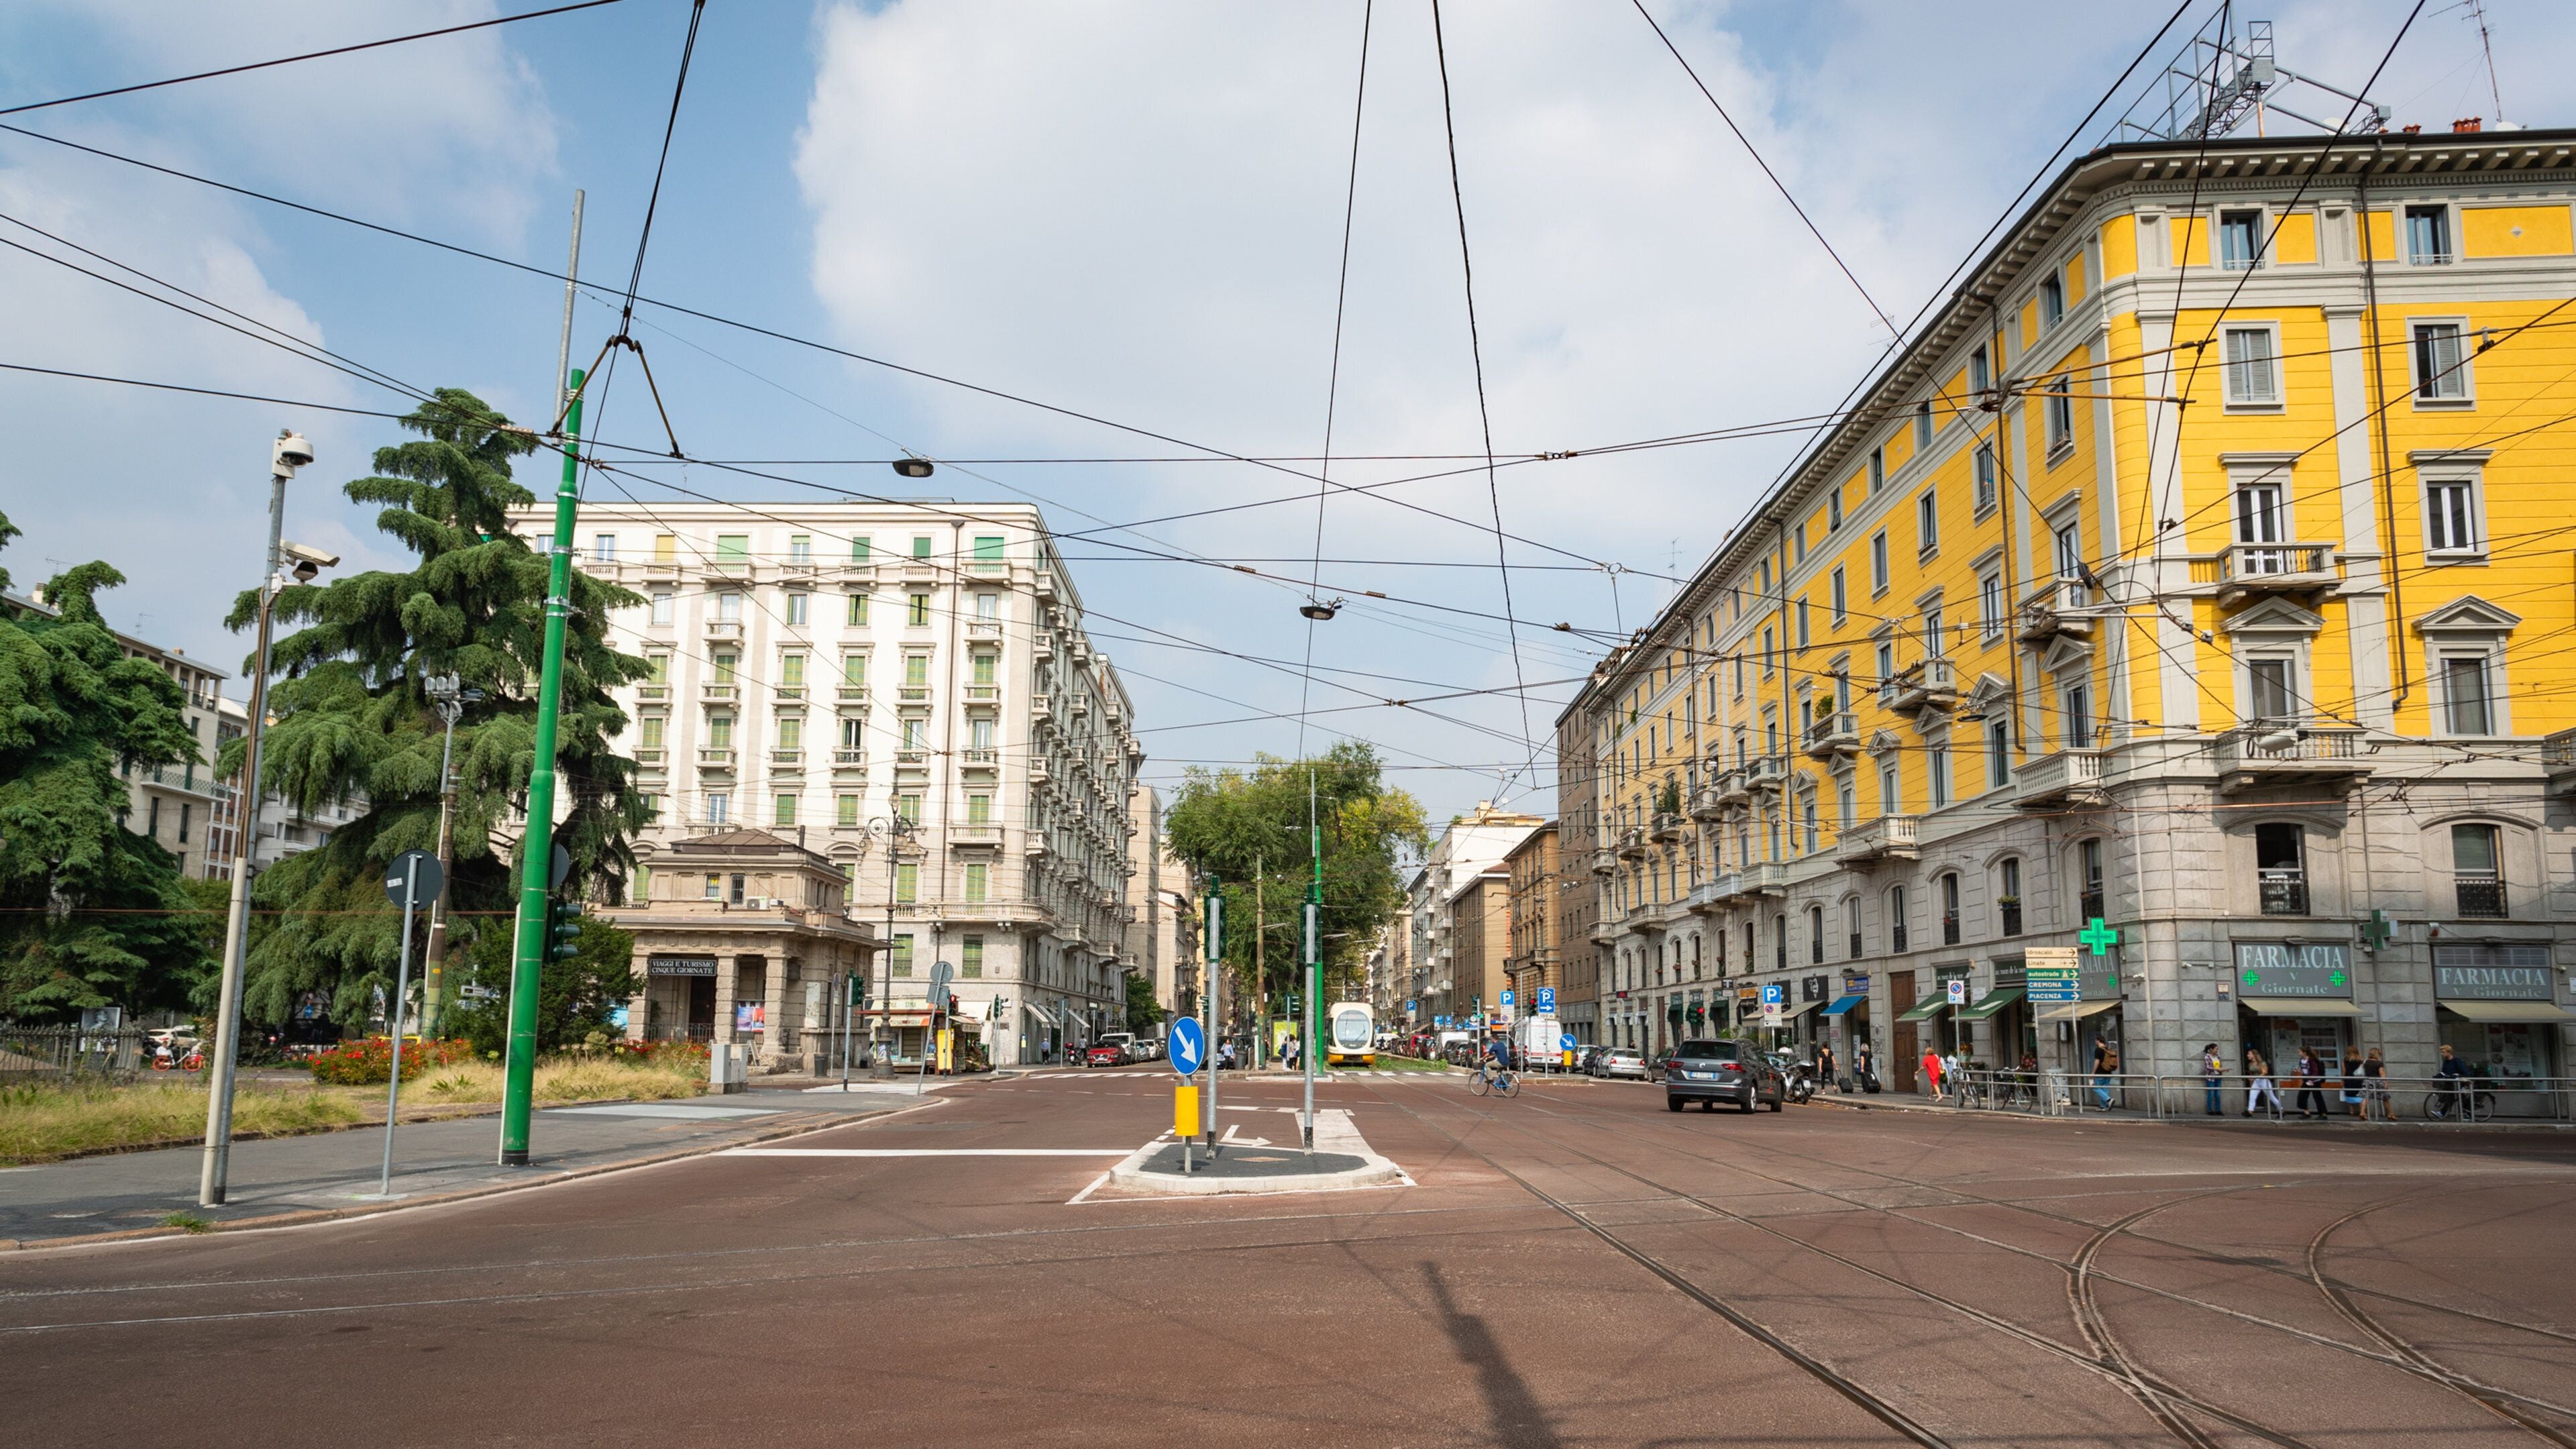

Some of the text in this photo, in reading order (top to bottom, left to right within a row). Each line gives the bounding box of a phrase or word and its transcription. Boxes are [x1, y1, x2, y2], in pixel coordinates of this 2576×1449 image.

[2080, 951, 2115, 974] RMACIA
[2241, 946, 2345, 968] FARMACIA
[2290, 972, 2299, 980] V
[2440, 968, 2546, 985] FARMACIA
[2261, 983, 2328, 994] Giornate
[2453, 987, 2542, 998] V Giornate
[1503, 993, 1511, 1004] P
[1542, 993, 1551, 1003] P
[1766, 988, 1777, 1002] P
